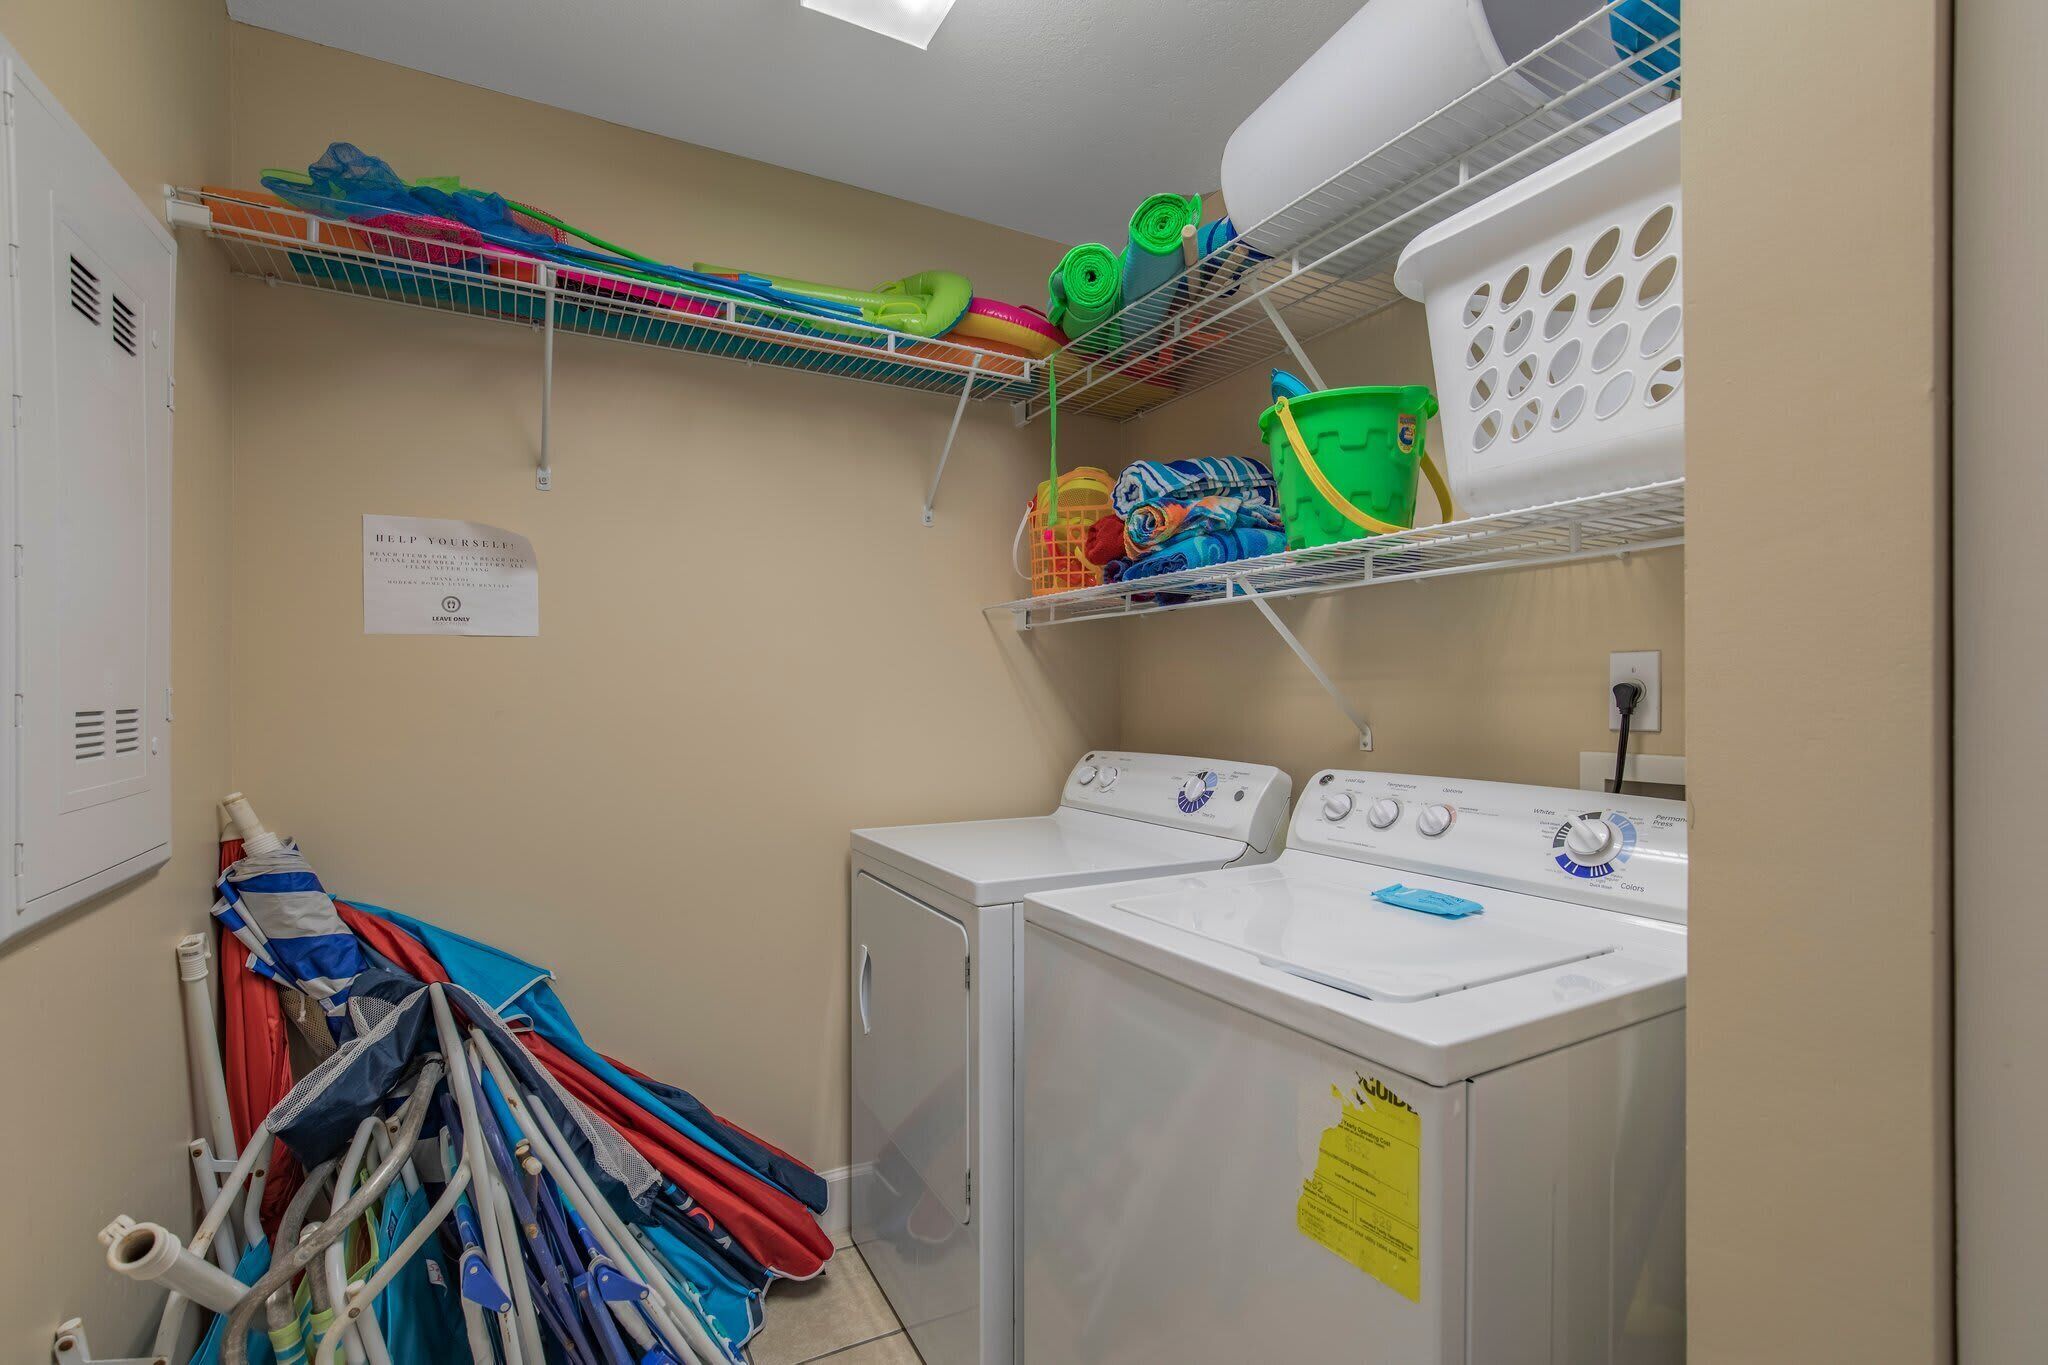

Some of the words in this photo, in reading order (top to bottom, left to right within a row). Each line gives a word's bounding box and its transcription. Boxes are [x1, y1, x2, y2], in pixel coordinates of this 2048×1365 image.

[376, 534, 417, 544] HELP
[428, 537, 517, 549] YOURSELF!
[1387, 781, 1417, 790] Temperature
[1533, 807, 1556, 816] Whites
[1655, 814, 1688, 823] Perman
[1652, 820, 1674, 828] Press
[1620, 882, 1645, 893] Colors
[1343, 1120, 1357, 1131] Yearly
[1357, 1126, 1379, 1143] Operating
[1379, 1137, 1391, 1147] Cost
